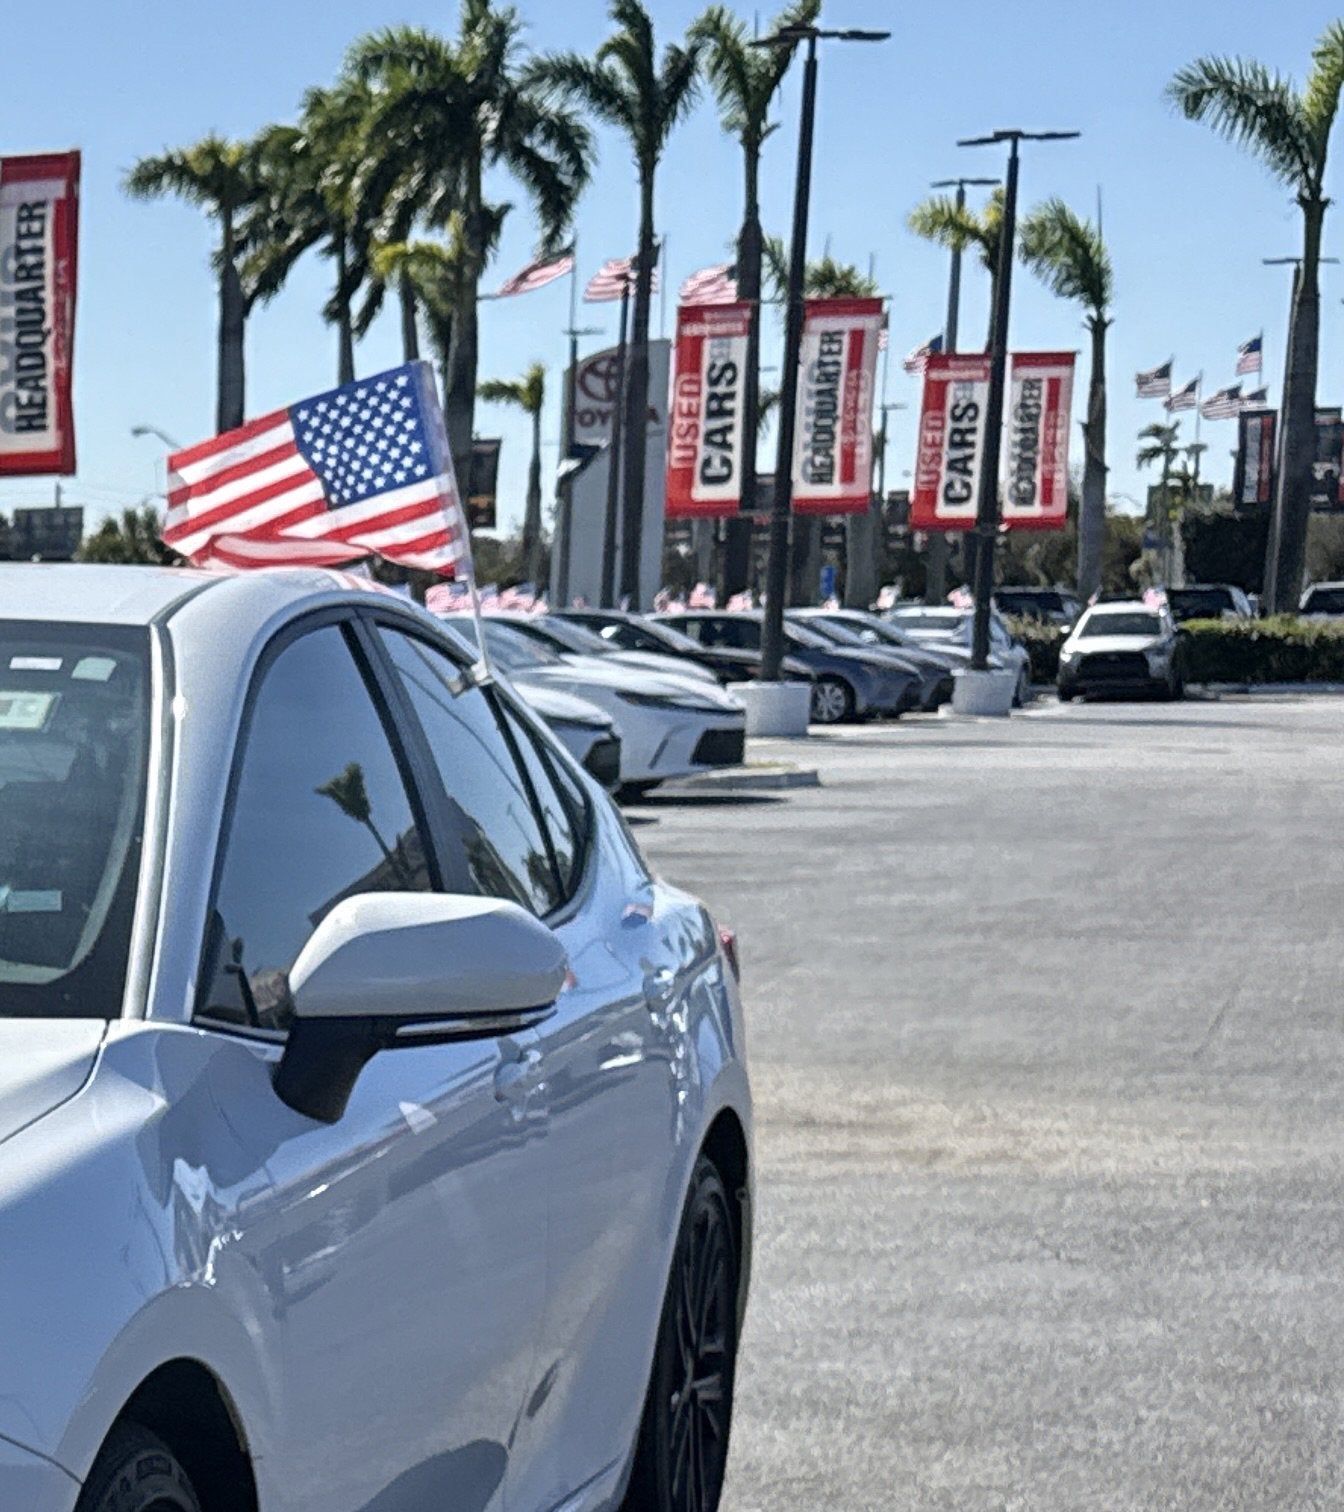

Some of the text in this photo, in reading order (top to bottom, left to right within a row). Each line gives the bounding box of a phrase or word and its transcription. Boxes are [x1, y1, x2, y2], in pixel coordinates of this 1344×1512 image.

[14, 199, 52, 433] HEADQUARTER
[670, 373, 701, 469] USED
[699, 361, 738, 486] CARS
[811, 330, 845, 486] HEADQUARTER
[917, 409, 945, 492] USED
[943, 402, 979, 506] CARS
